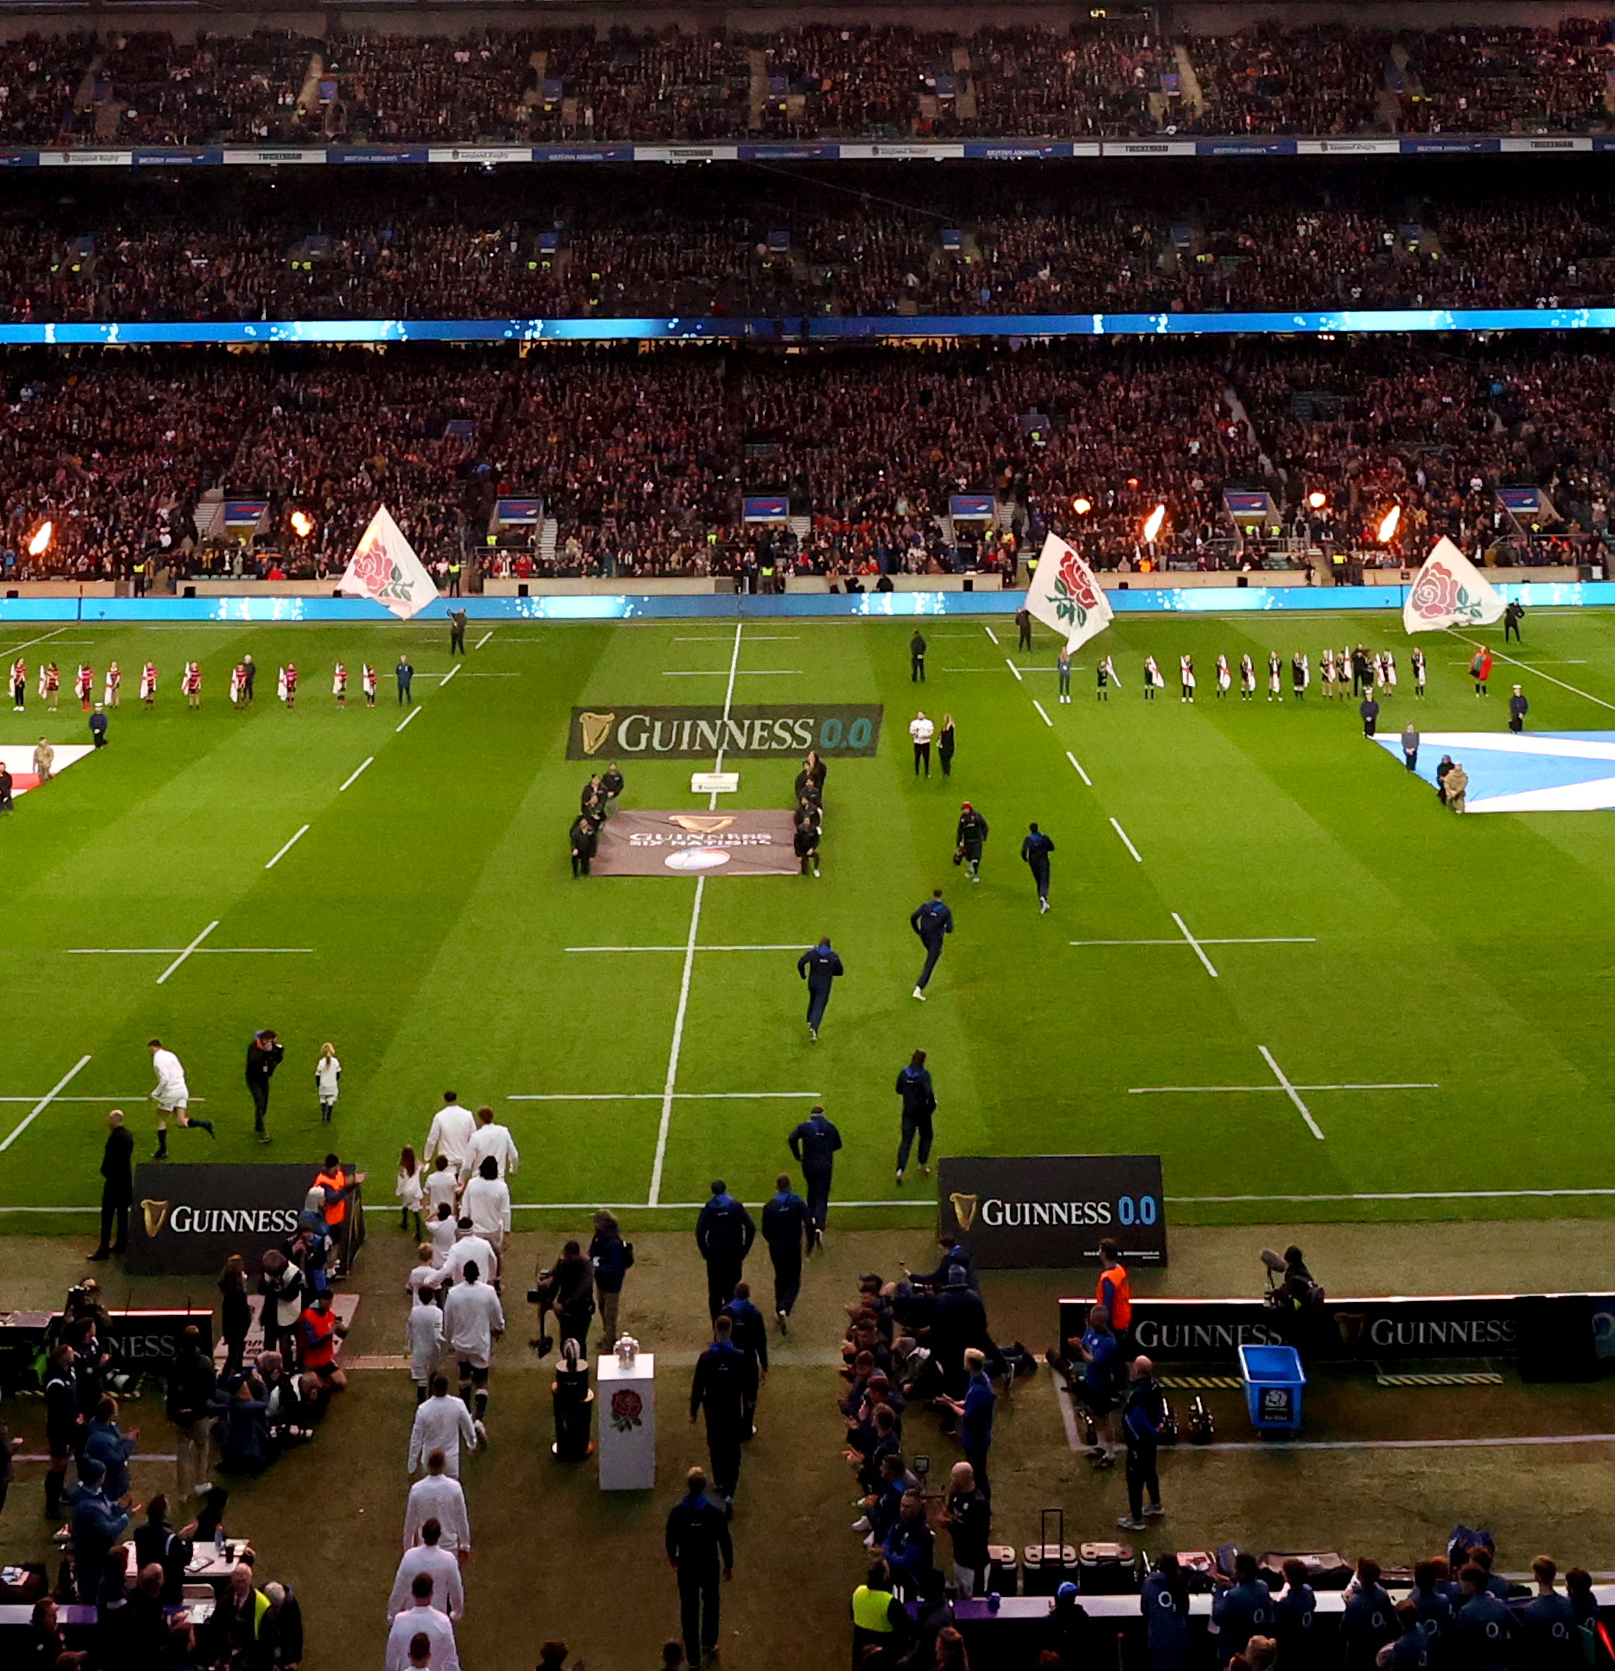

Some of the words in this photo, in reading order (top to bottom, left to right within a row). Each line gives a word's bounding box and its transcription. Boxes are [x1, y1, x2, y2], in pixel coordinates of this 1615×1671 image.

[617, 714, 815, 751] GUINNESS
[819, 717, 873, 749] 0.0
[170, 1205, 299, 1233] GUINNESS
[982, 1198, 1112, 1226] GUINNESS
[1117, 1195, 1156, 1226] 0.0
[1135, 1320, 1283, 1349] GUINNESS
[1371, 1319, 1517, 1346] GUINNESS
